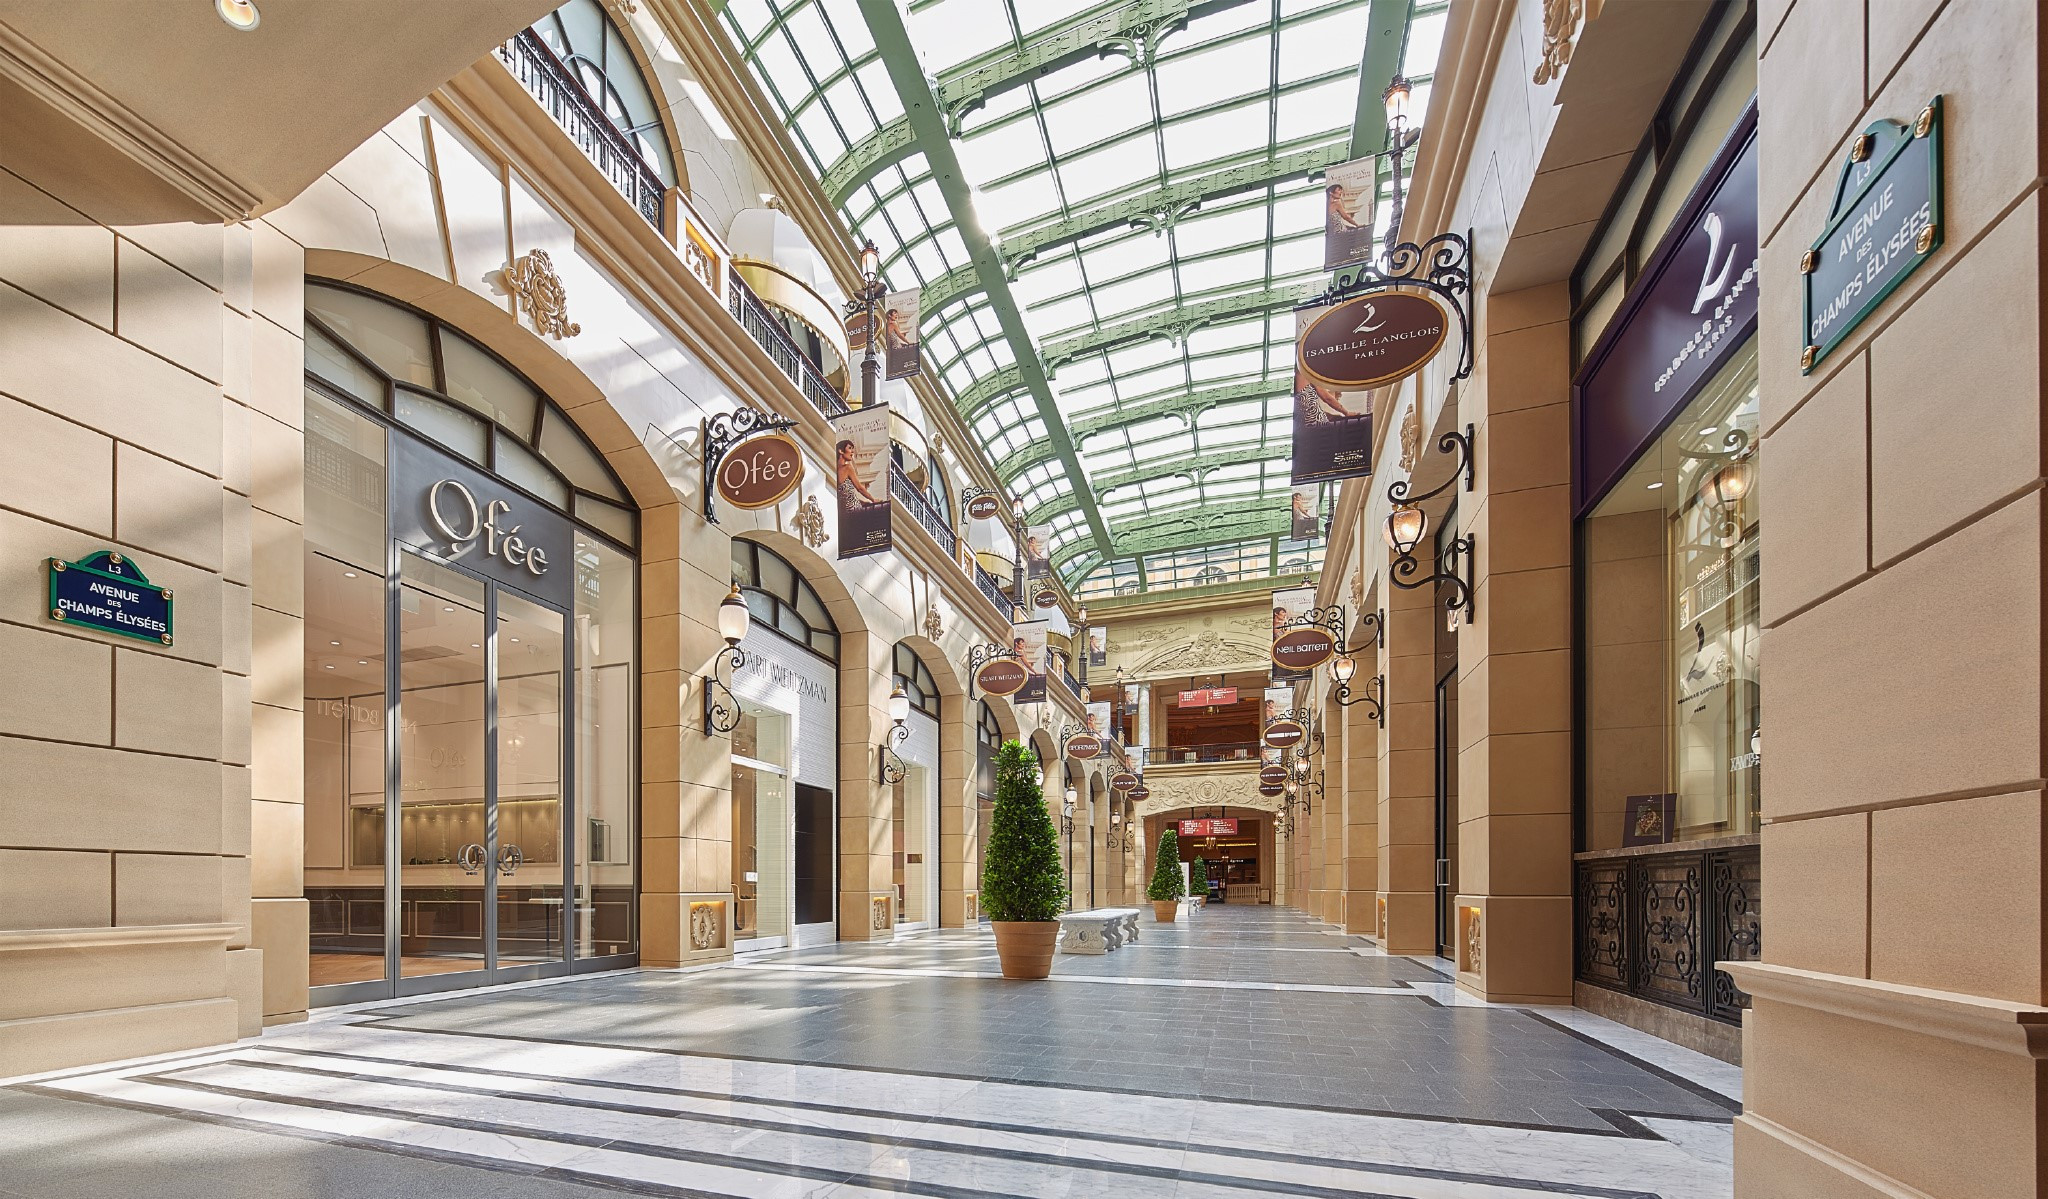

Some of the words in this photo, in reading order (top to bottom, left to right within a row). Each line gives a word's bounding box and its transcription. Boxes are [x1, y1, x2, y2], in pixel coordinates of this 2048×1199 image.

[1856, 160, 1871, 188] L3
[1838, 183, 1895, 263] AVENUE
[1856, 240, 1873, 263] DES
[1811, 272, 1864, 341] CHAMPS
[1866, 201, 1931, 283] ÉLYSÉES
[1305, 339, 1367, 358] ISABELLE
[1373, 326, 1440, 345] LANGLOIS
[1354, 348, 1386, 360] PARIS
[108, 564, 122, 575] L3
[89, 582, 140, 604] AVENUE
[107, 599, 122, 609] DES
[58, 597, 113, 620] CHAMPS
[116, 609, 166, 633] ÉLYSÉES
[770, 661, 827, 704] WEITZMAN
